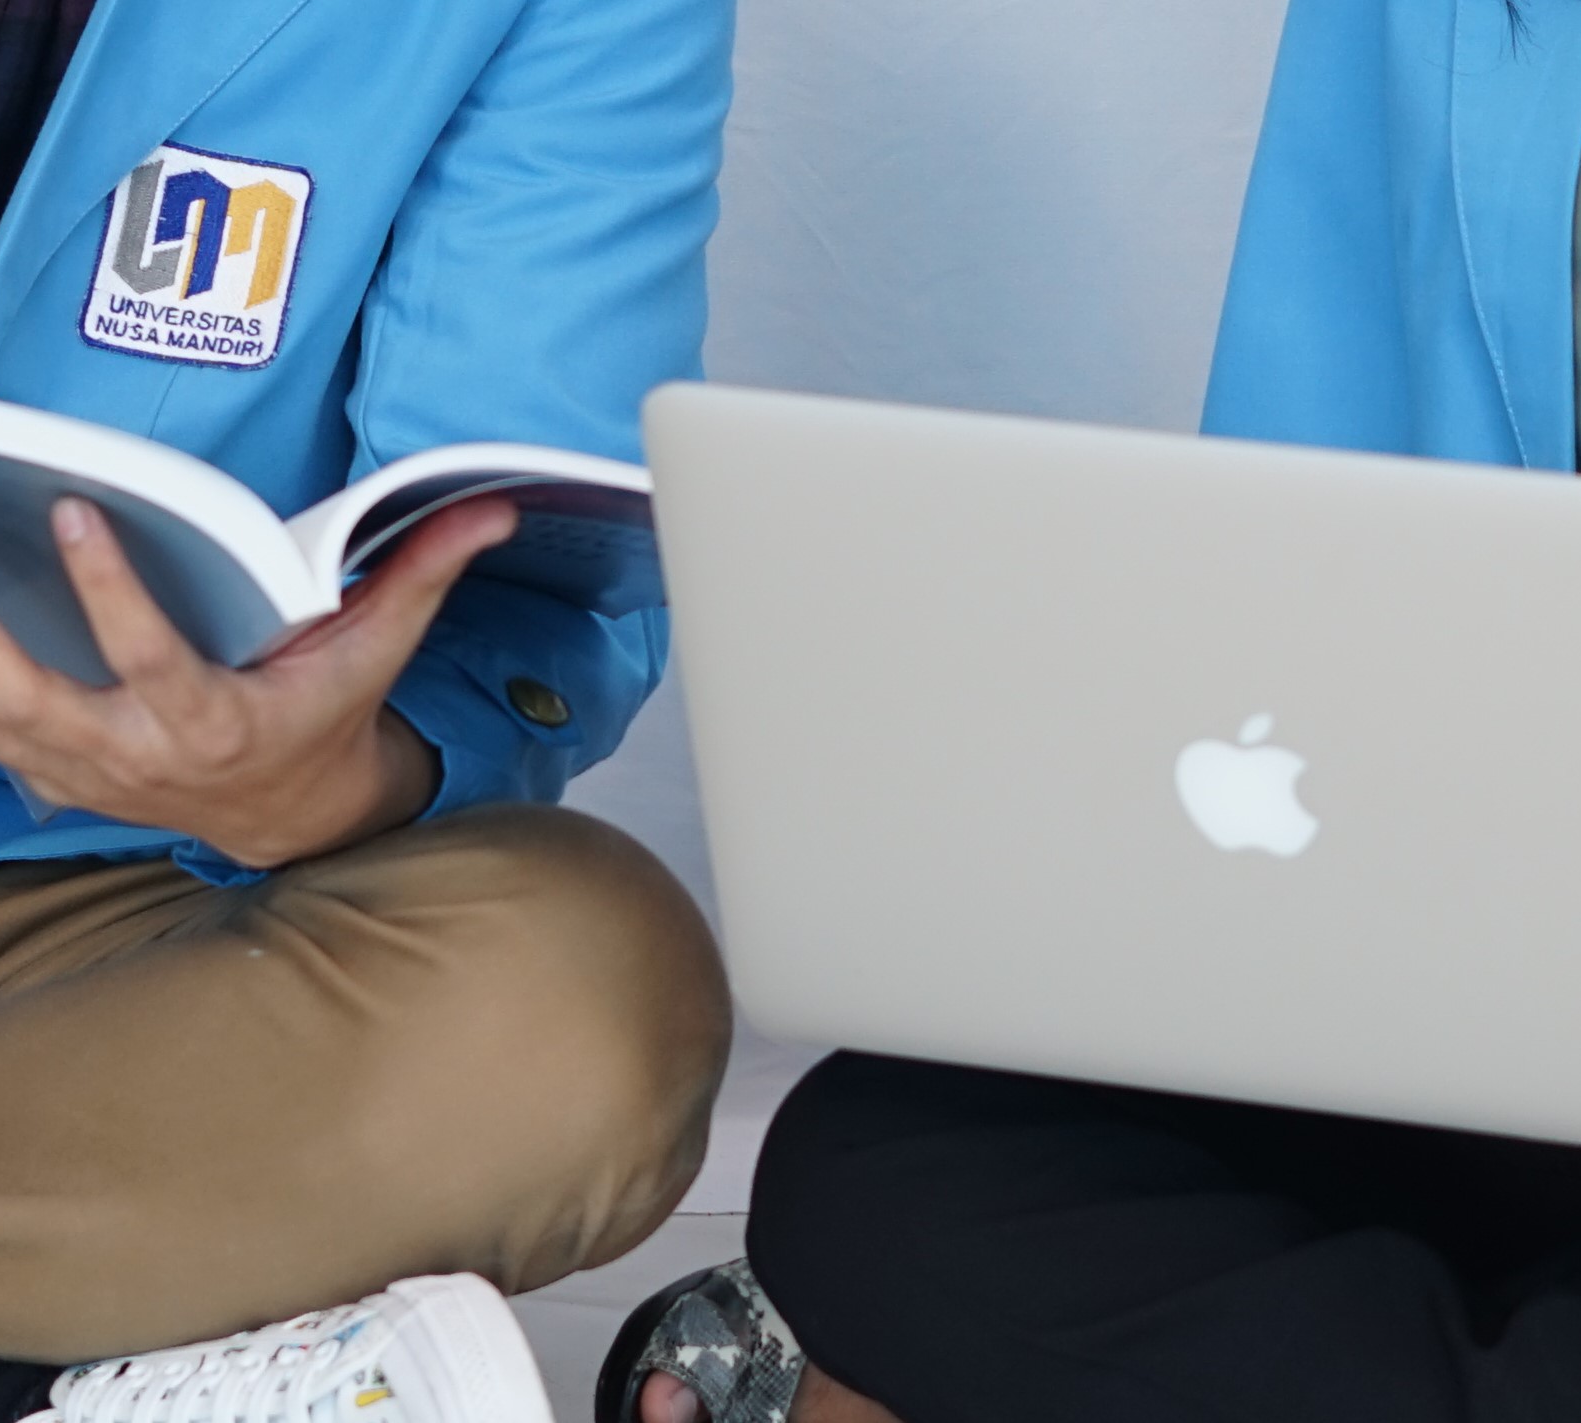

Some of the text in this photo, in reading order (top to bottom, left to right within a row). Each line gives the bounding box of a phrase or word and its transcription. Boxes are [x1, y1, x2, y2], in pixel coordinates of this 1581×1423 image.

[95, 315, 264, 357] NUSA MANDIRI
[109, 293, 261, 337] UNIVERSITAS
